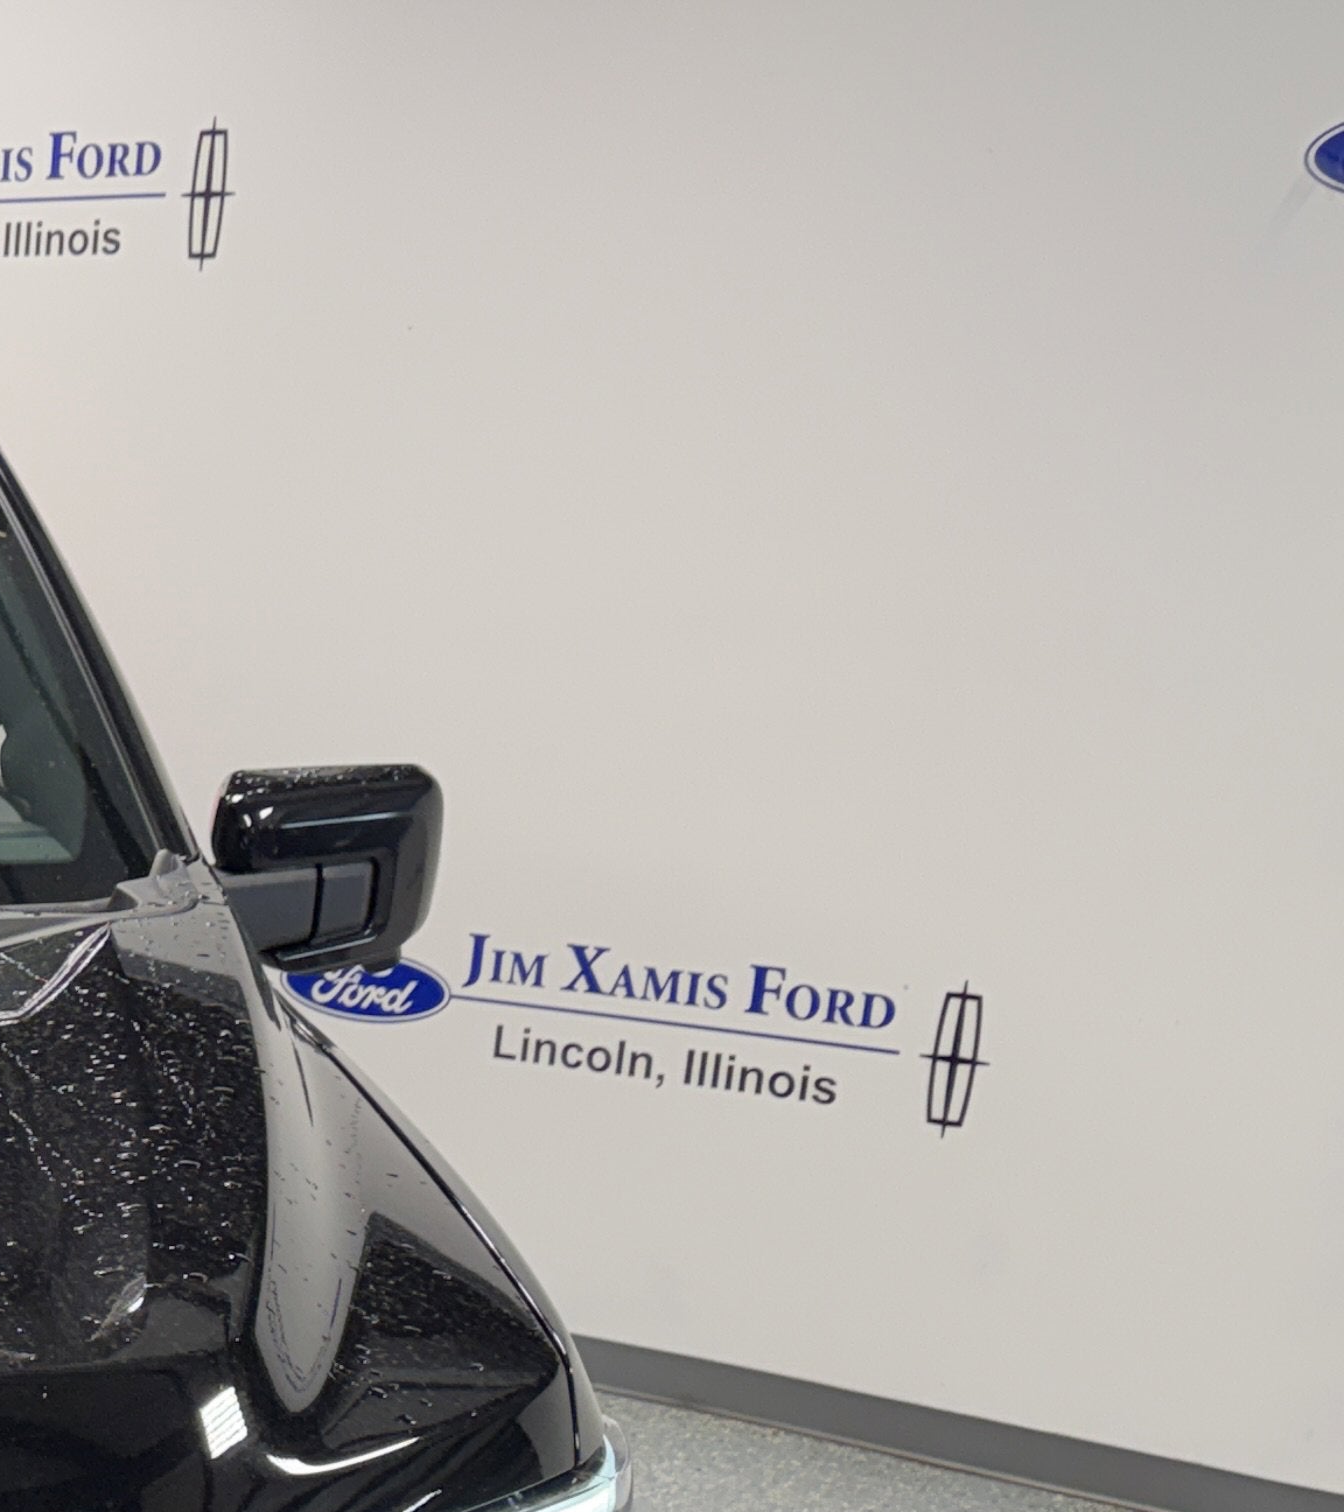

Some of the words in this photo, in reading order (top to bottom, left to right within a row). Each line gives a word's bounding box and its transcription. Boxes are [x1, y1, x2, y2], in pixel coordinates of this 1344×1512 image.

[46, 130, 163, 181] FORD
[2, 217, 122, 259] Illinois
[310, 963, 419, 1014] Ford
[461, 932, 551, 990] JIM
[563, 944, 730, 1012] XAMIS
[744, 963, 897, 1030] FORD
[492, 1023, 668, 1090] Lincoln,
[682, 1047, 838, 1106] Illinois
